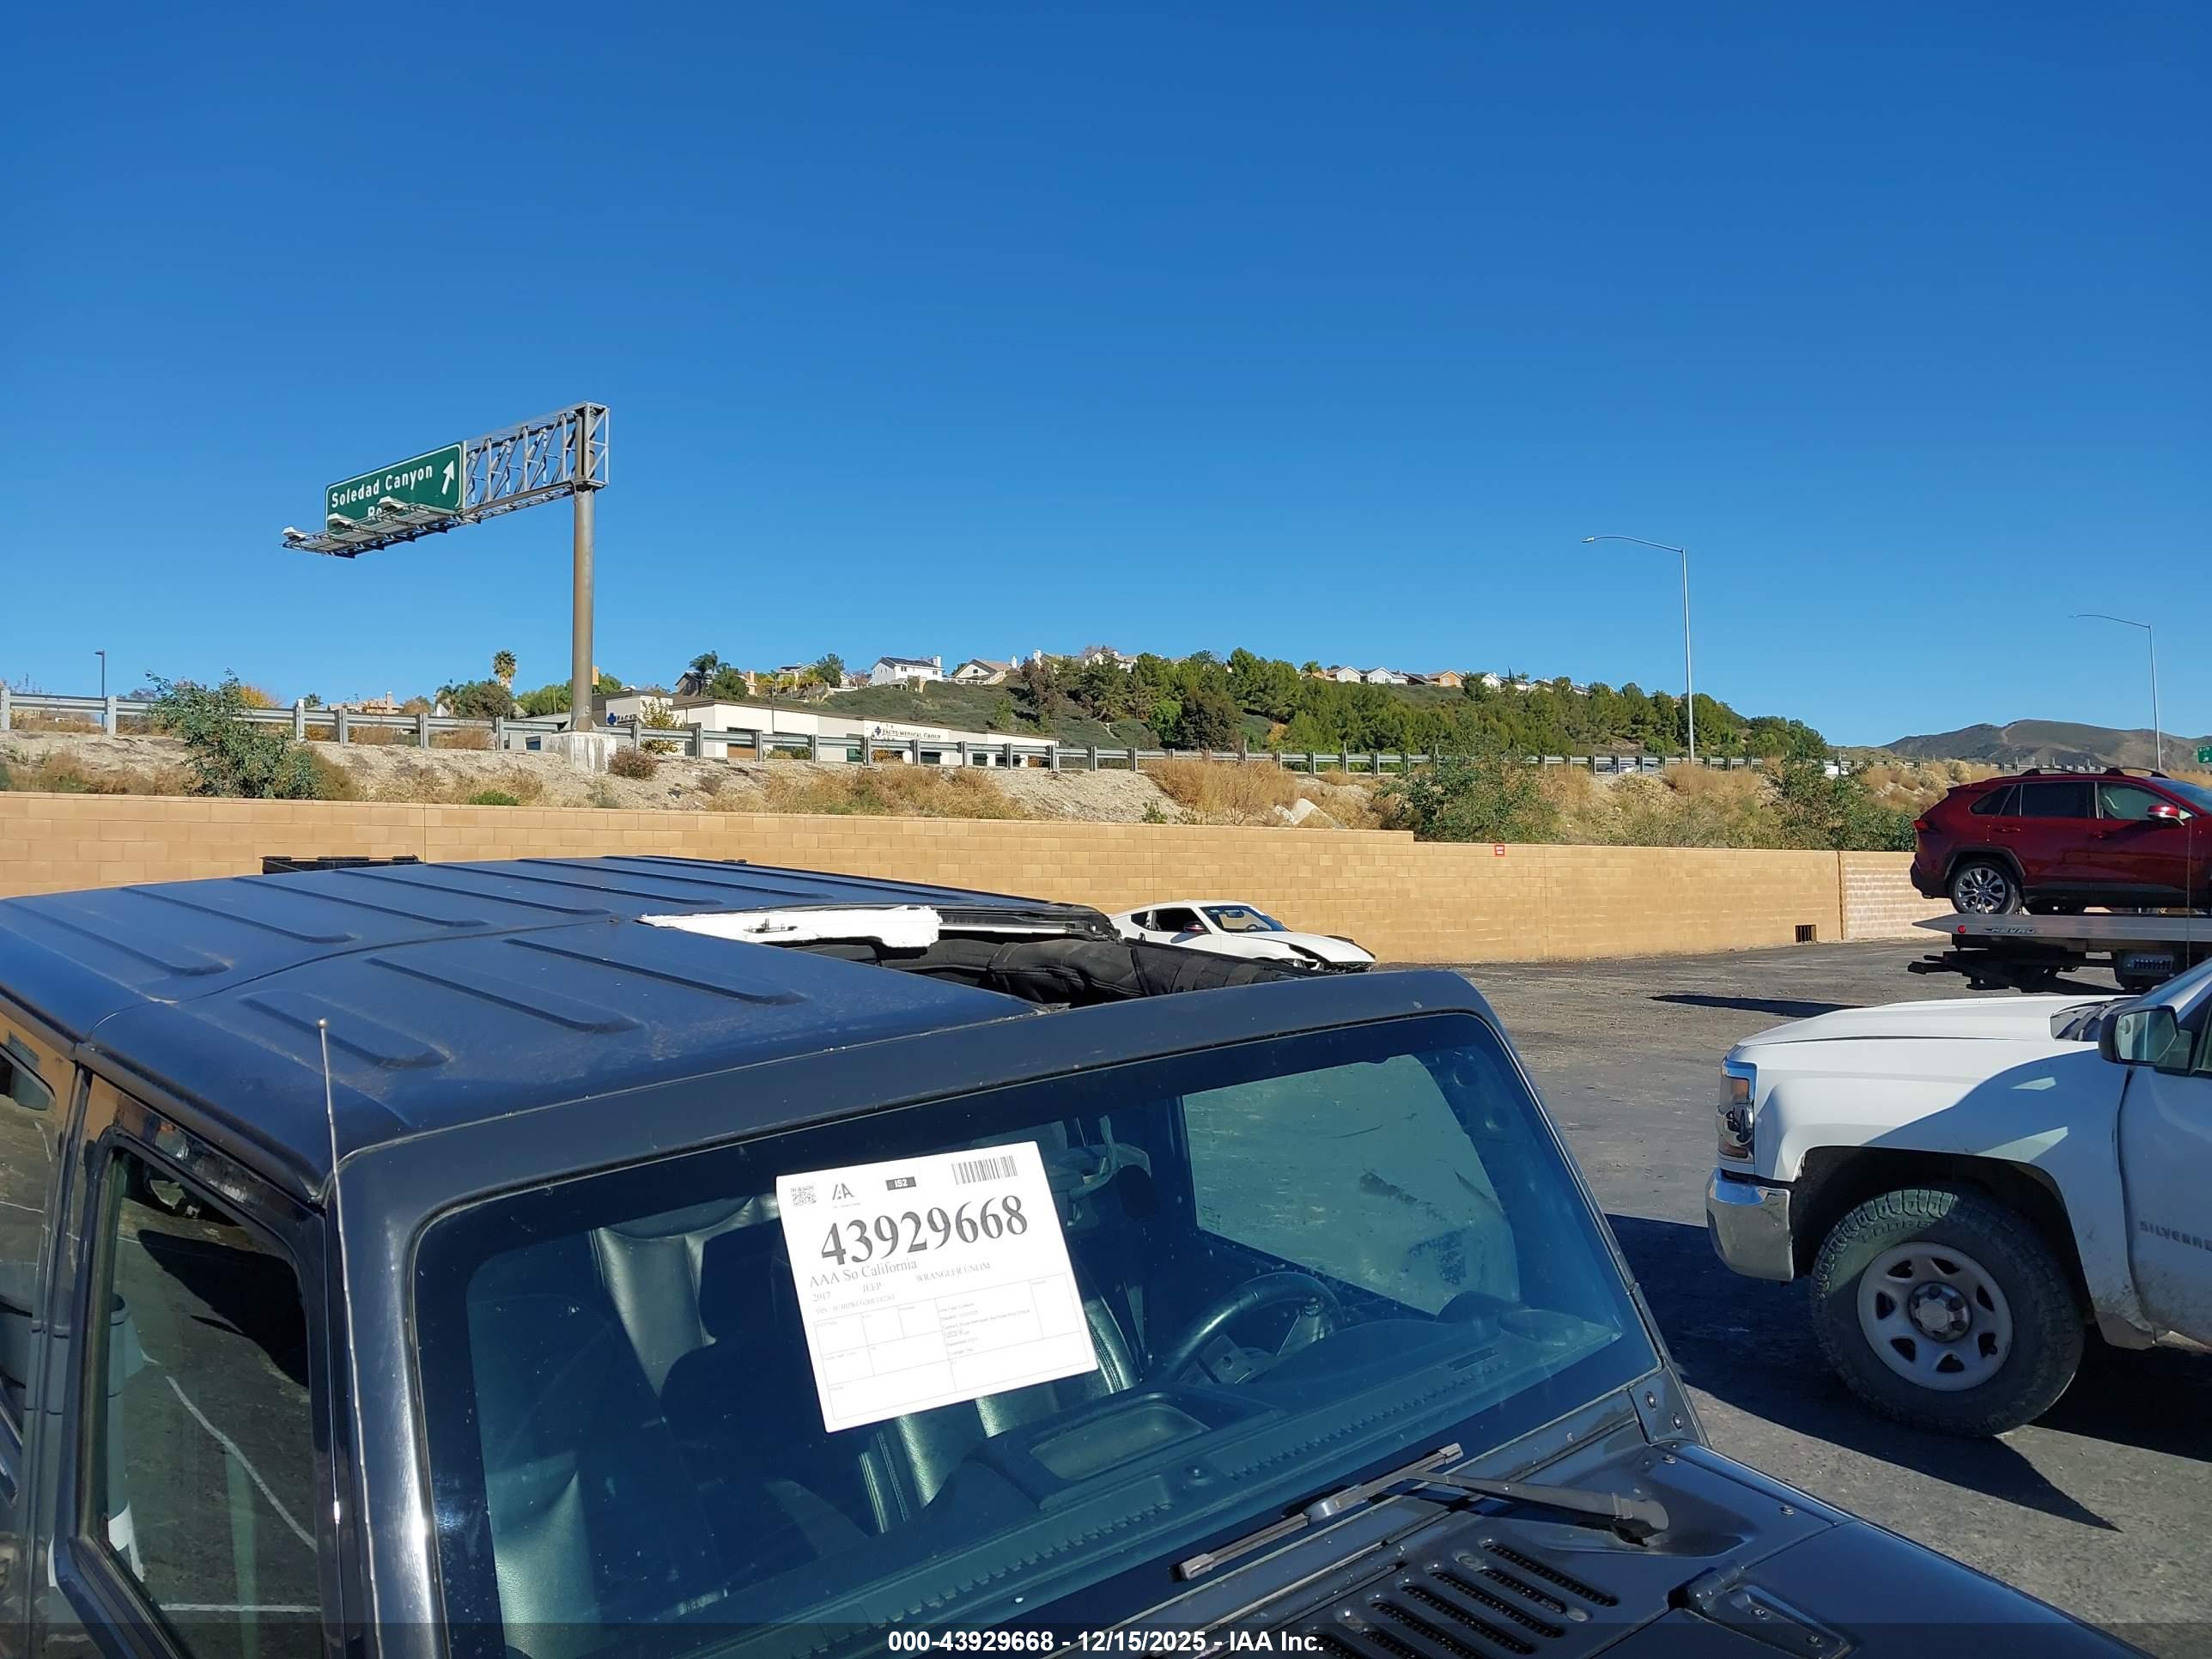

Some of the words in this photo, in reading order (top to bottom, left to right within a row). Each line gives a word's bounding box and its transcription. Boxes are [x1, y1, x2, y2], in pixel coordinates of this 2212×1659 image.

[331, 478, 380, 508] Soledad
[385, 465, 433, 491] Canyon
[821, 1194, 1028, 1266] 43929668
[810, 1272, 841, 1288] AAA
[843, 1269, 859, 1280] So
[861, 1259, 918, 1278] California
[811, 1291, 831, 1302] 2017
[916, 1267, 963, 1283] WRANGLER
